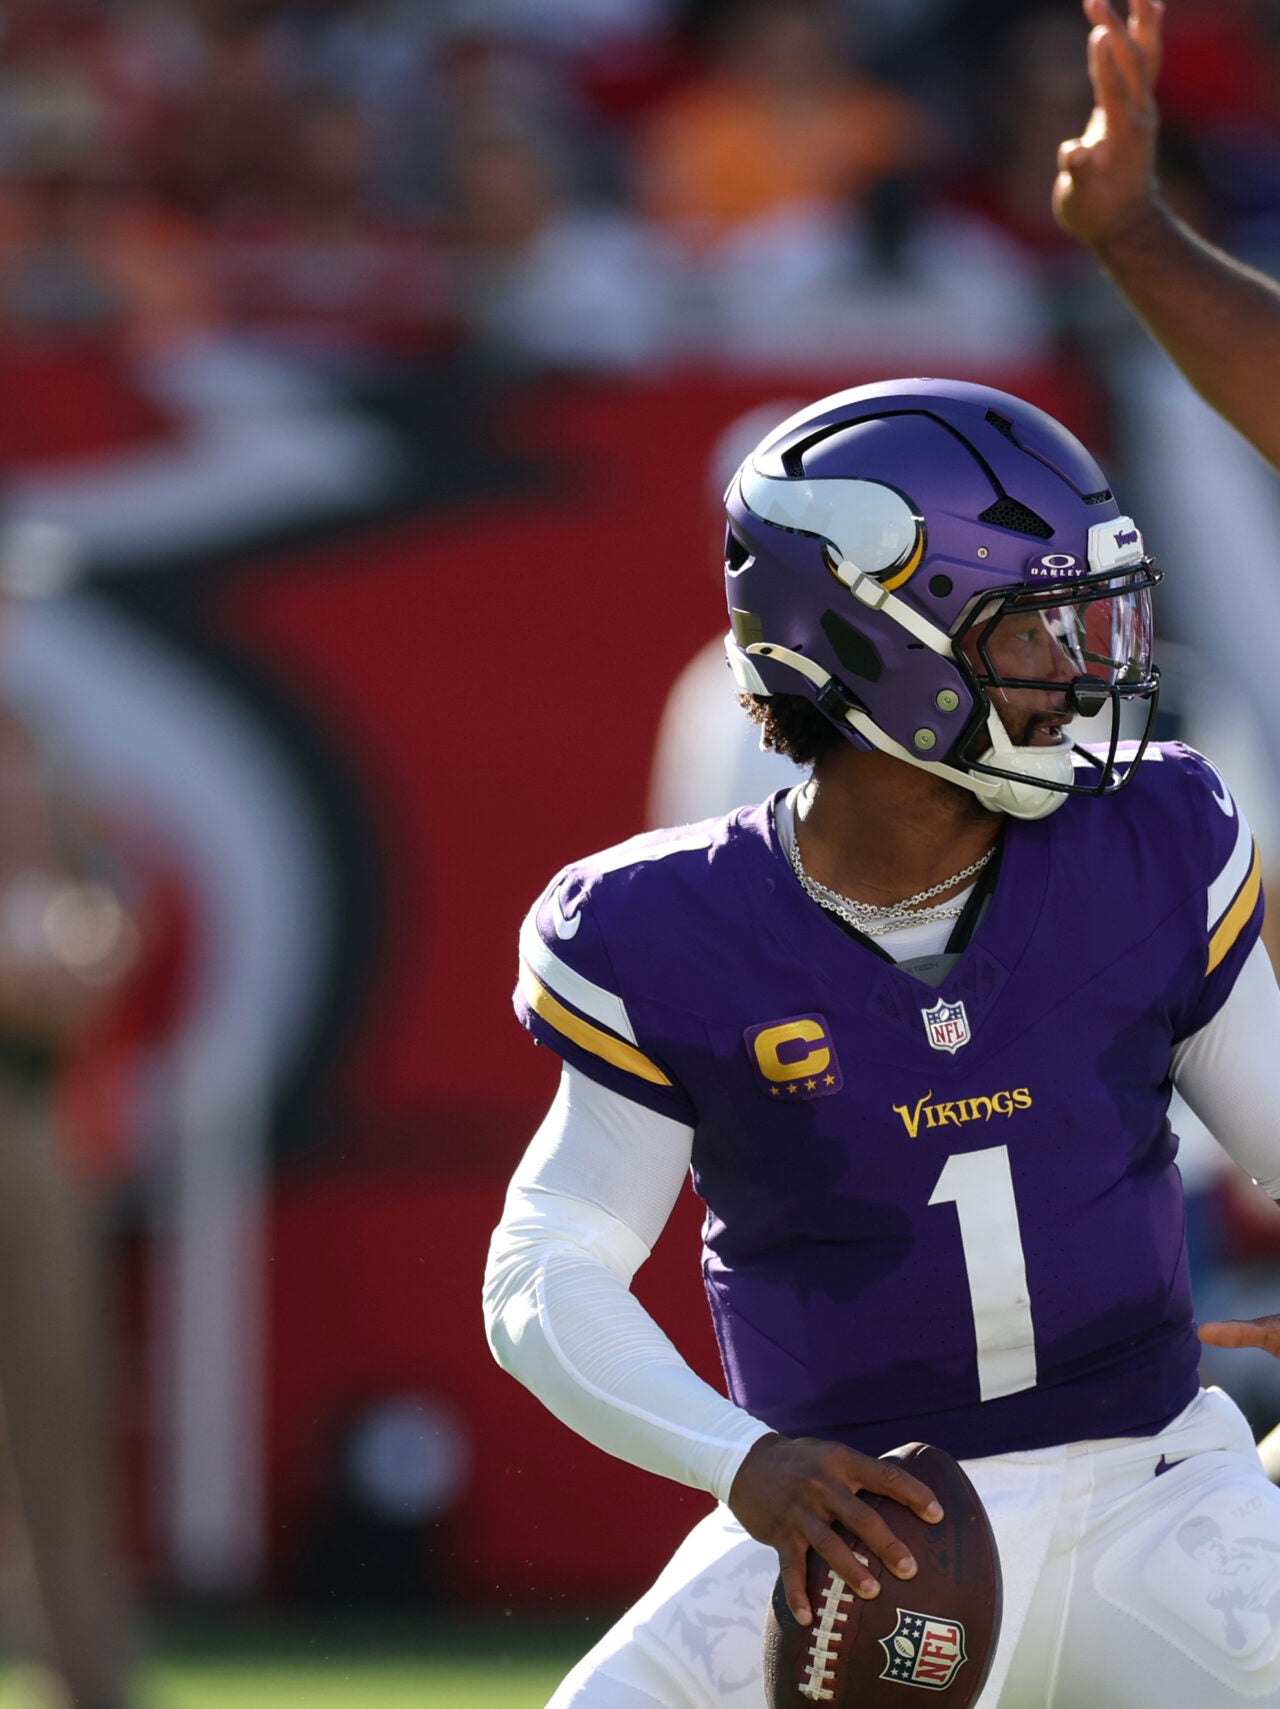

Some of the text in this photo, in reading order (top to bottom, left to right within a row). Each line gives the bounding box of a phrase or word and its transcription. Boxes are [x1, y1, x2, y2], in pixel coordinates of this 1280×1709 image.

[1031, 568, 1081, 577] OAKLEY
[754, 1018, 831, 1083] C
[933, 1021, 964, 1044] NFL
[892, 1088, 1033, 1139] VIKINGS
[927, 1144, 1037, 1402] 1
[914, 1627, 958, 1684] NFL
